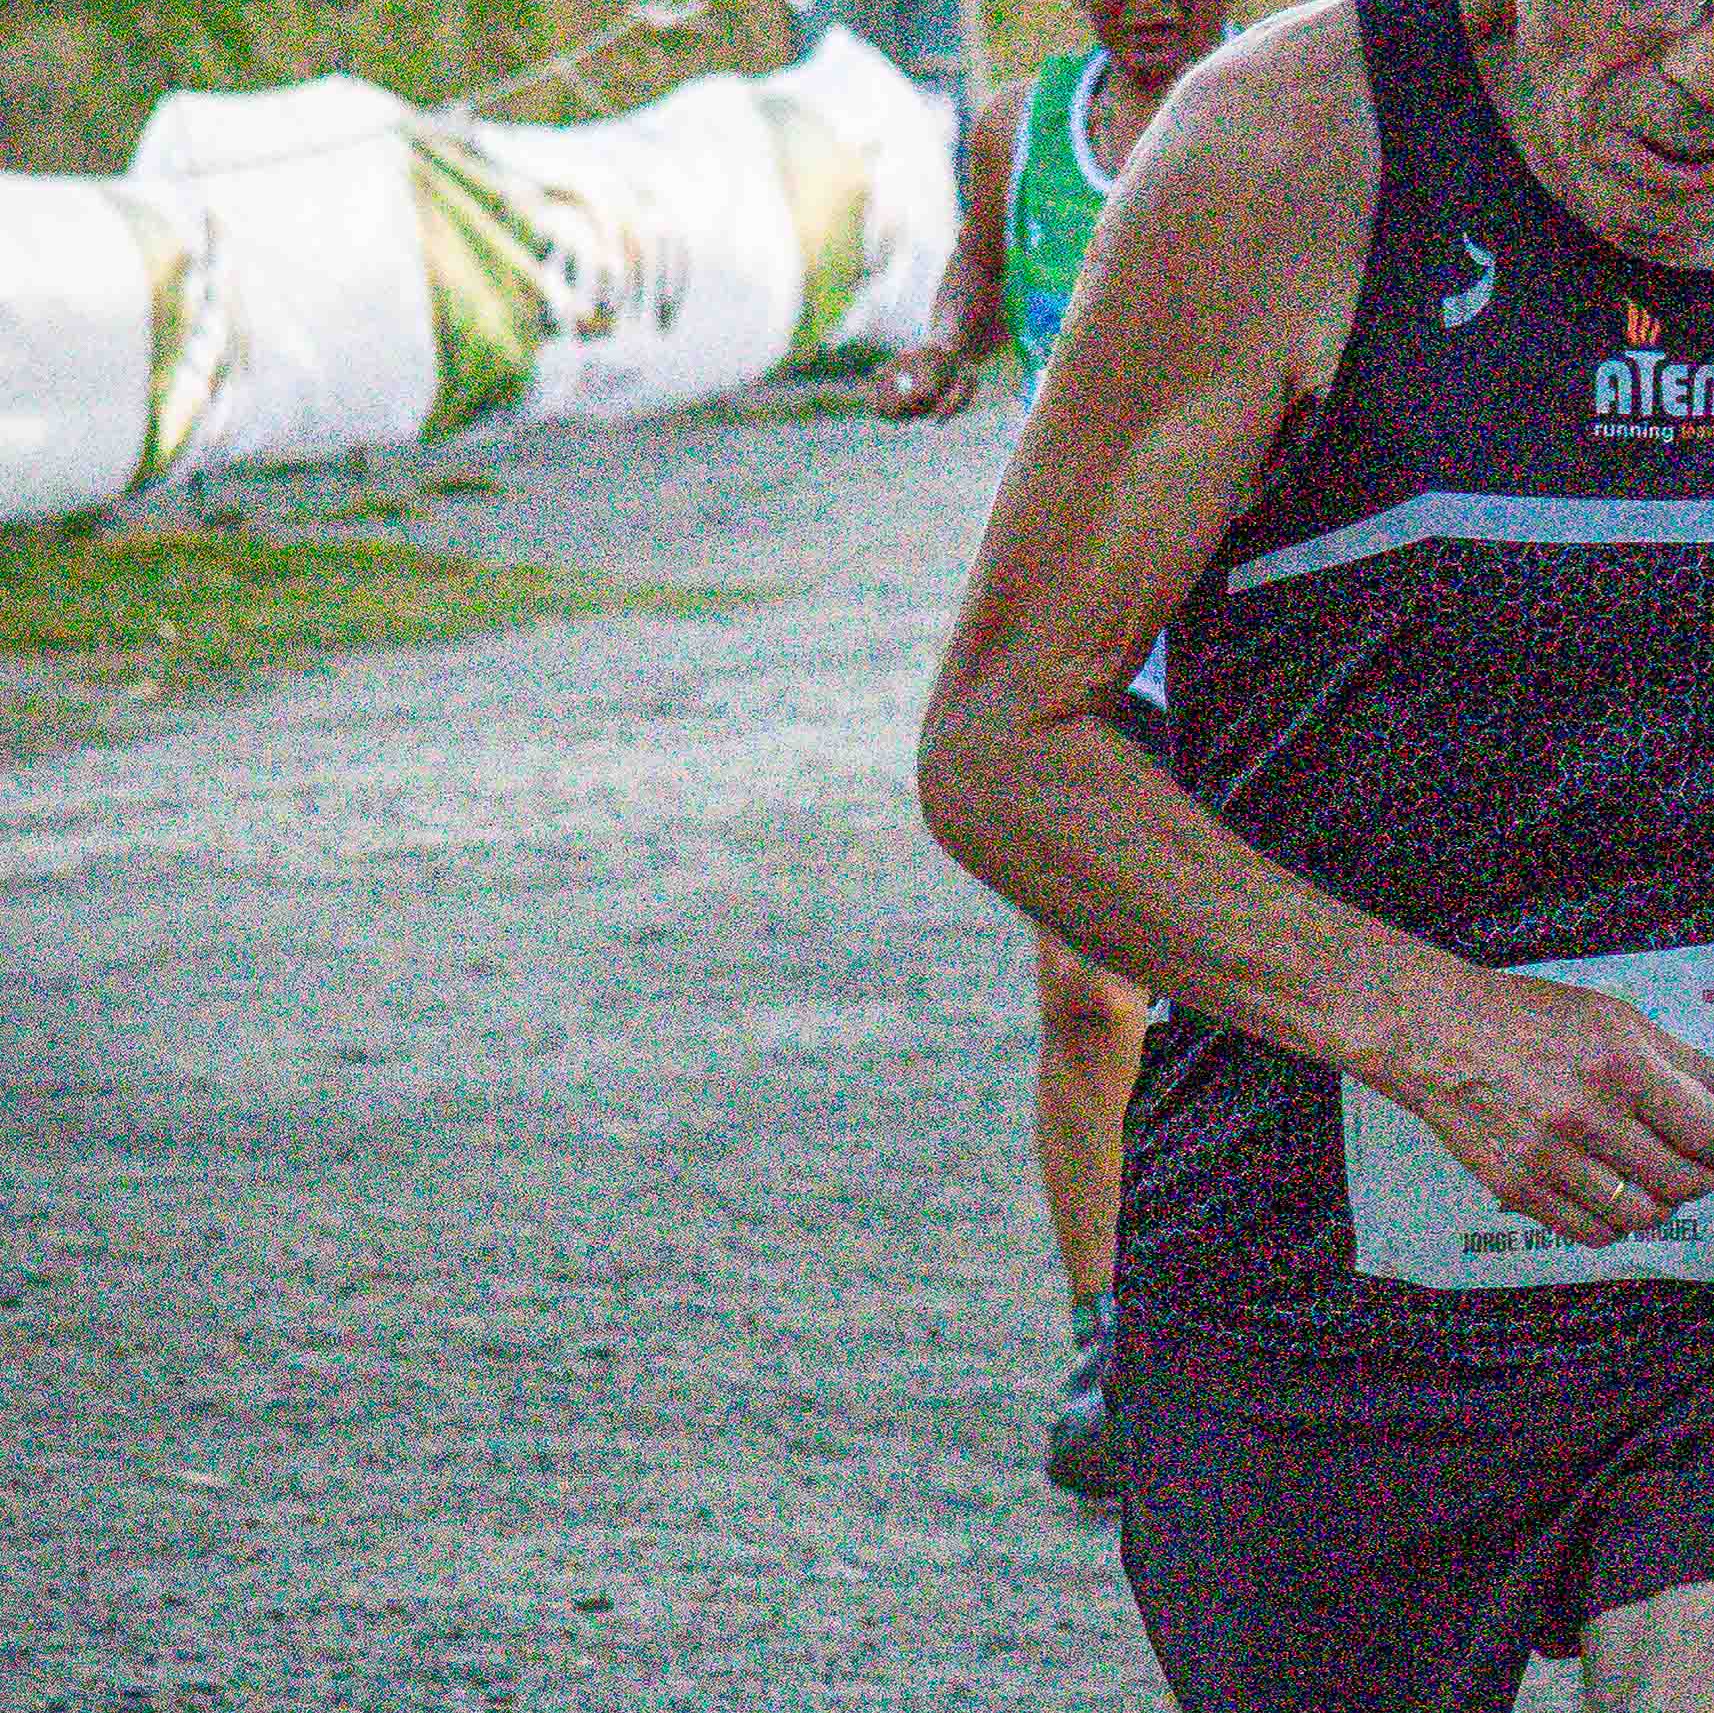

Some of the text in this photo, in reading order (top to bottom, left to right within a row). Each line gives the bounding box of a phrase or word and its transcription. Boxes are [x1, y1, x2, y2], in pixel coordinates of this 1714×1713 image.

[1593, 423, 1675, 444] running
[1462, 1230, 1519, 1254] JORGE
[1524, 1228, 1576, 1252] VICTO
